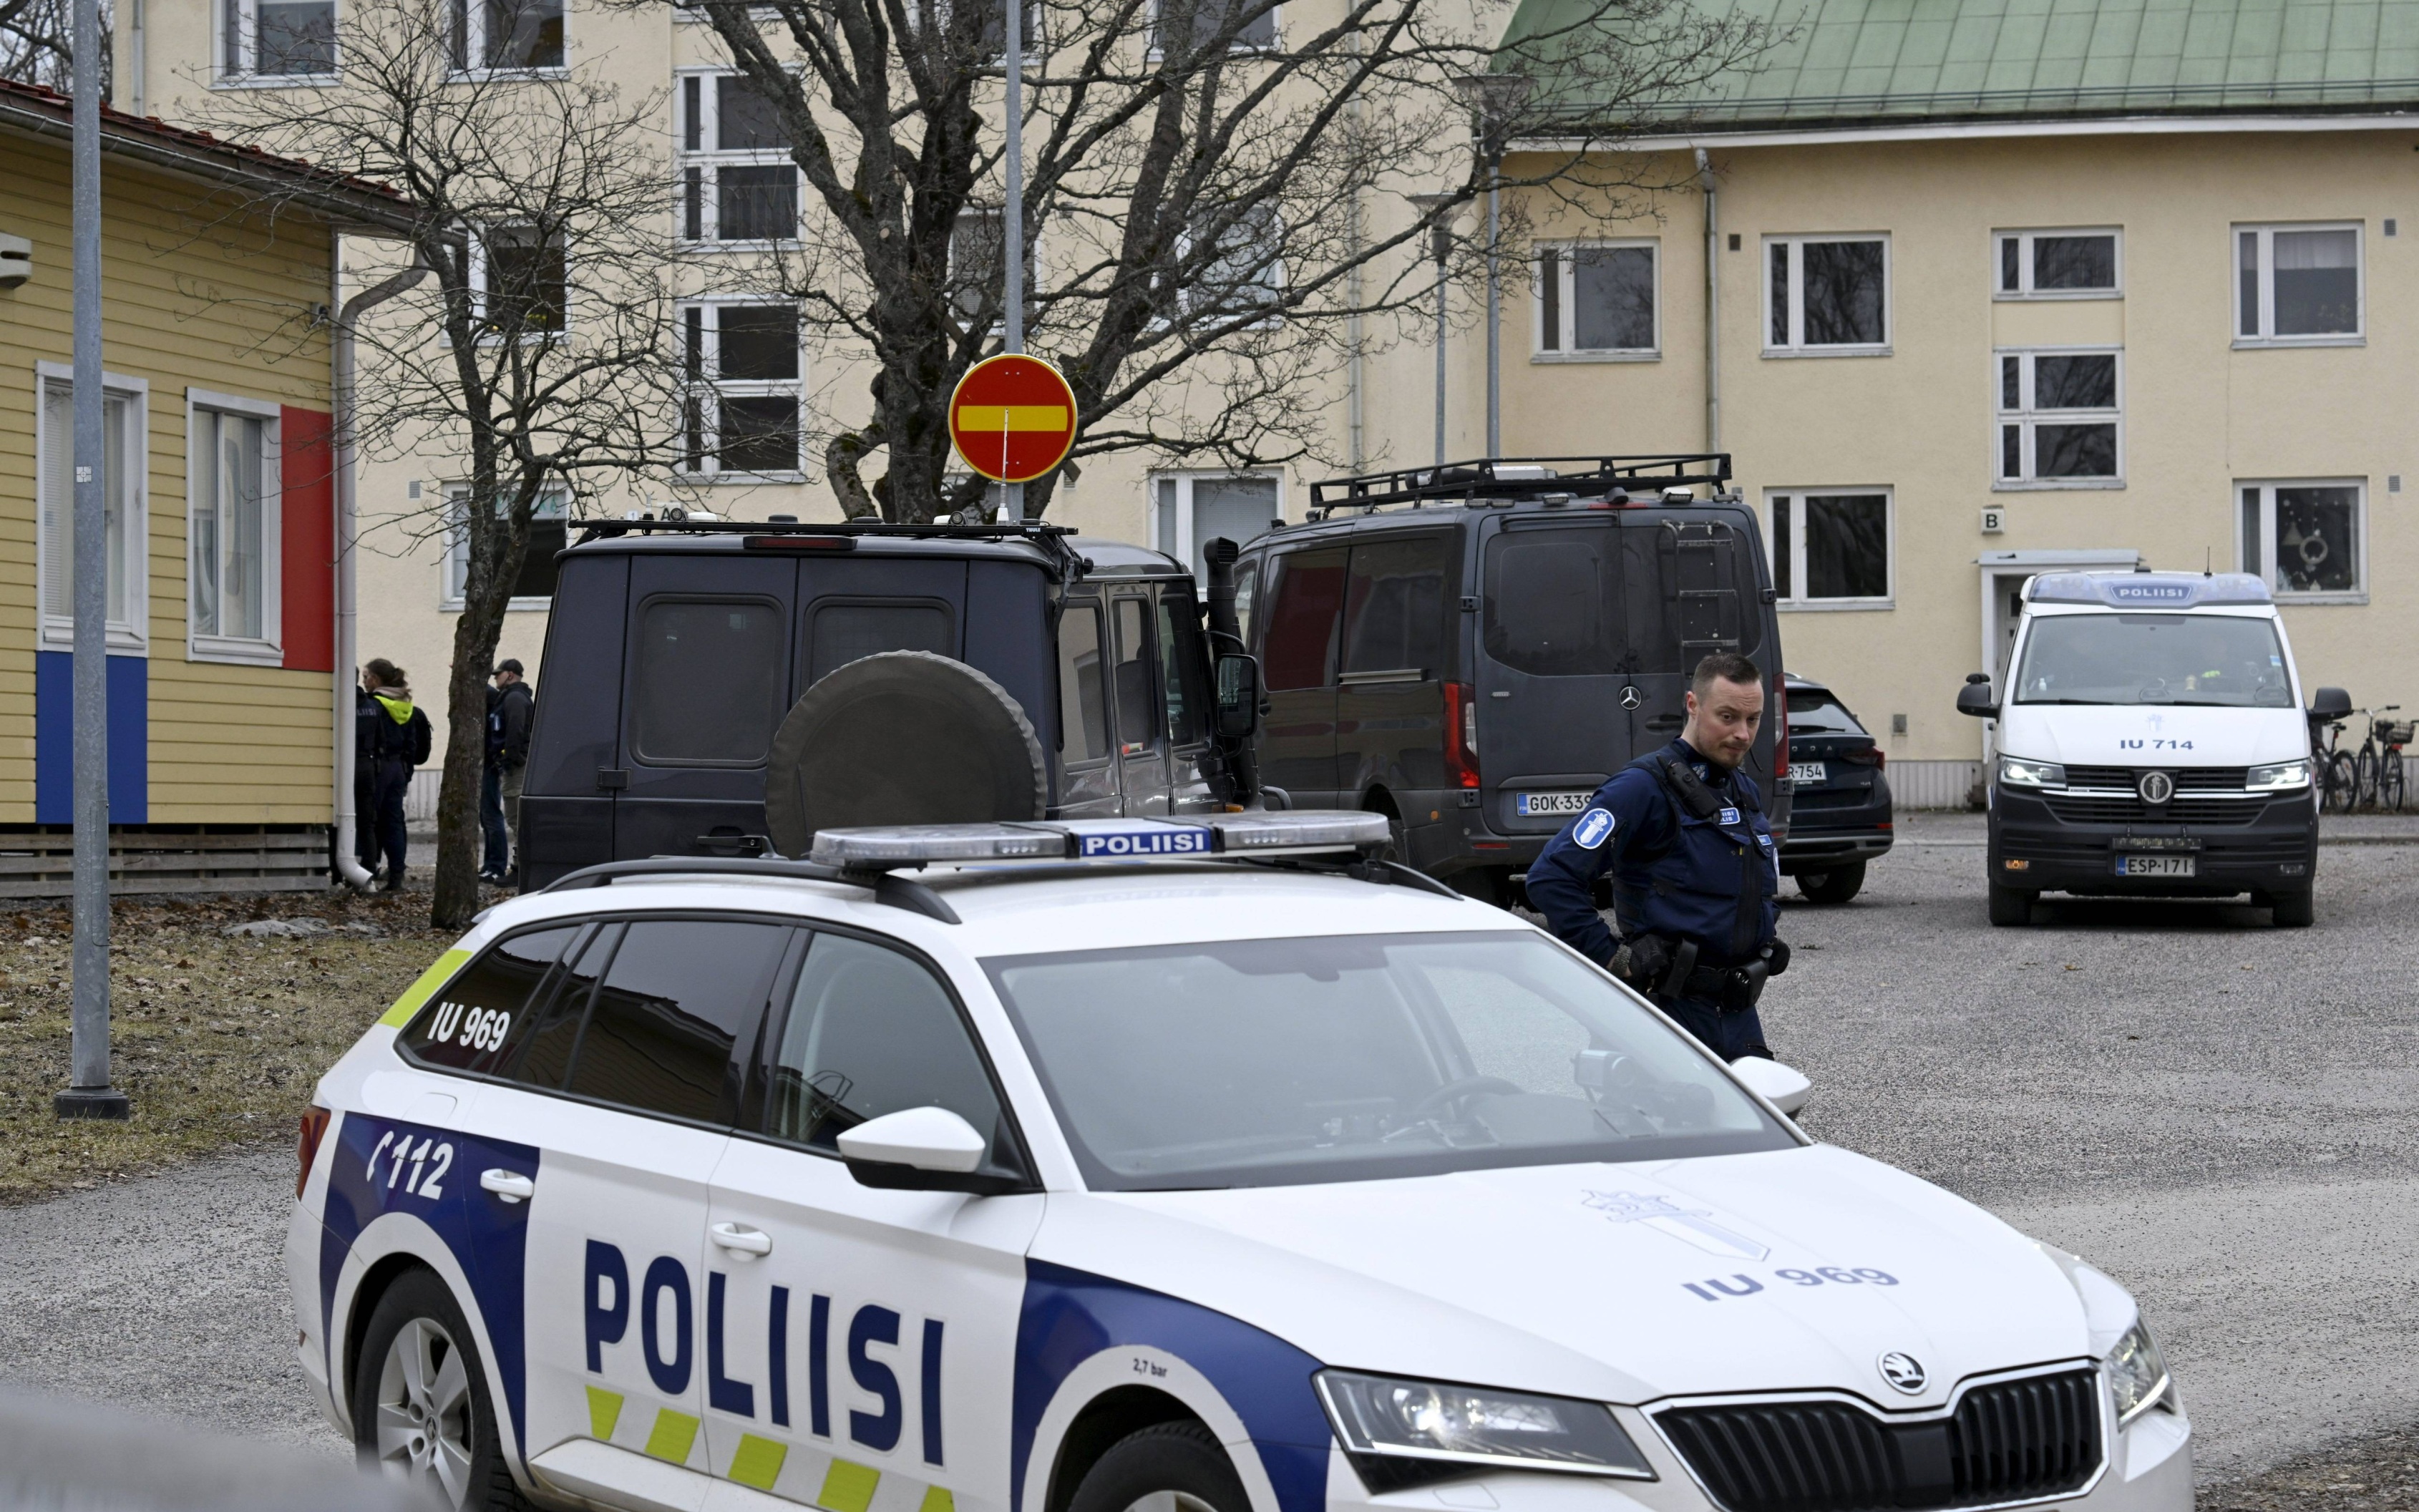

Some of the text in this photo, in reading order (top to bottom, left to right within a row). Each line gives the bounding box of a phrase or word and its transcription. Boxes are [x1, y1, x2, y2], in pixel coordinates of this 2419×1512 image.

[1986, 514, 1998, 528] B
[2120, 588, 2183, 597] POLIISI
[2121, 739, 2194, 750] IU 714
[1788, 764, 1822, 779] R-754
[1086, 833, 1204, 854] POLIISI
[2128, 859, 2188, 873] ESP-171
[427, 1001, 511, 1053] IU 969
[387, 1134, 454, 1201] 112
[1680, 1267, 1900, 1302] IU 969
[585, 1238, 945, 1468] POLIISI
[1133, 1358, 1167, 1378] 2,7 bar
